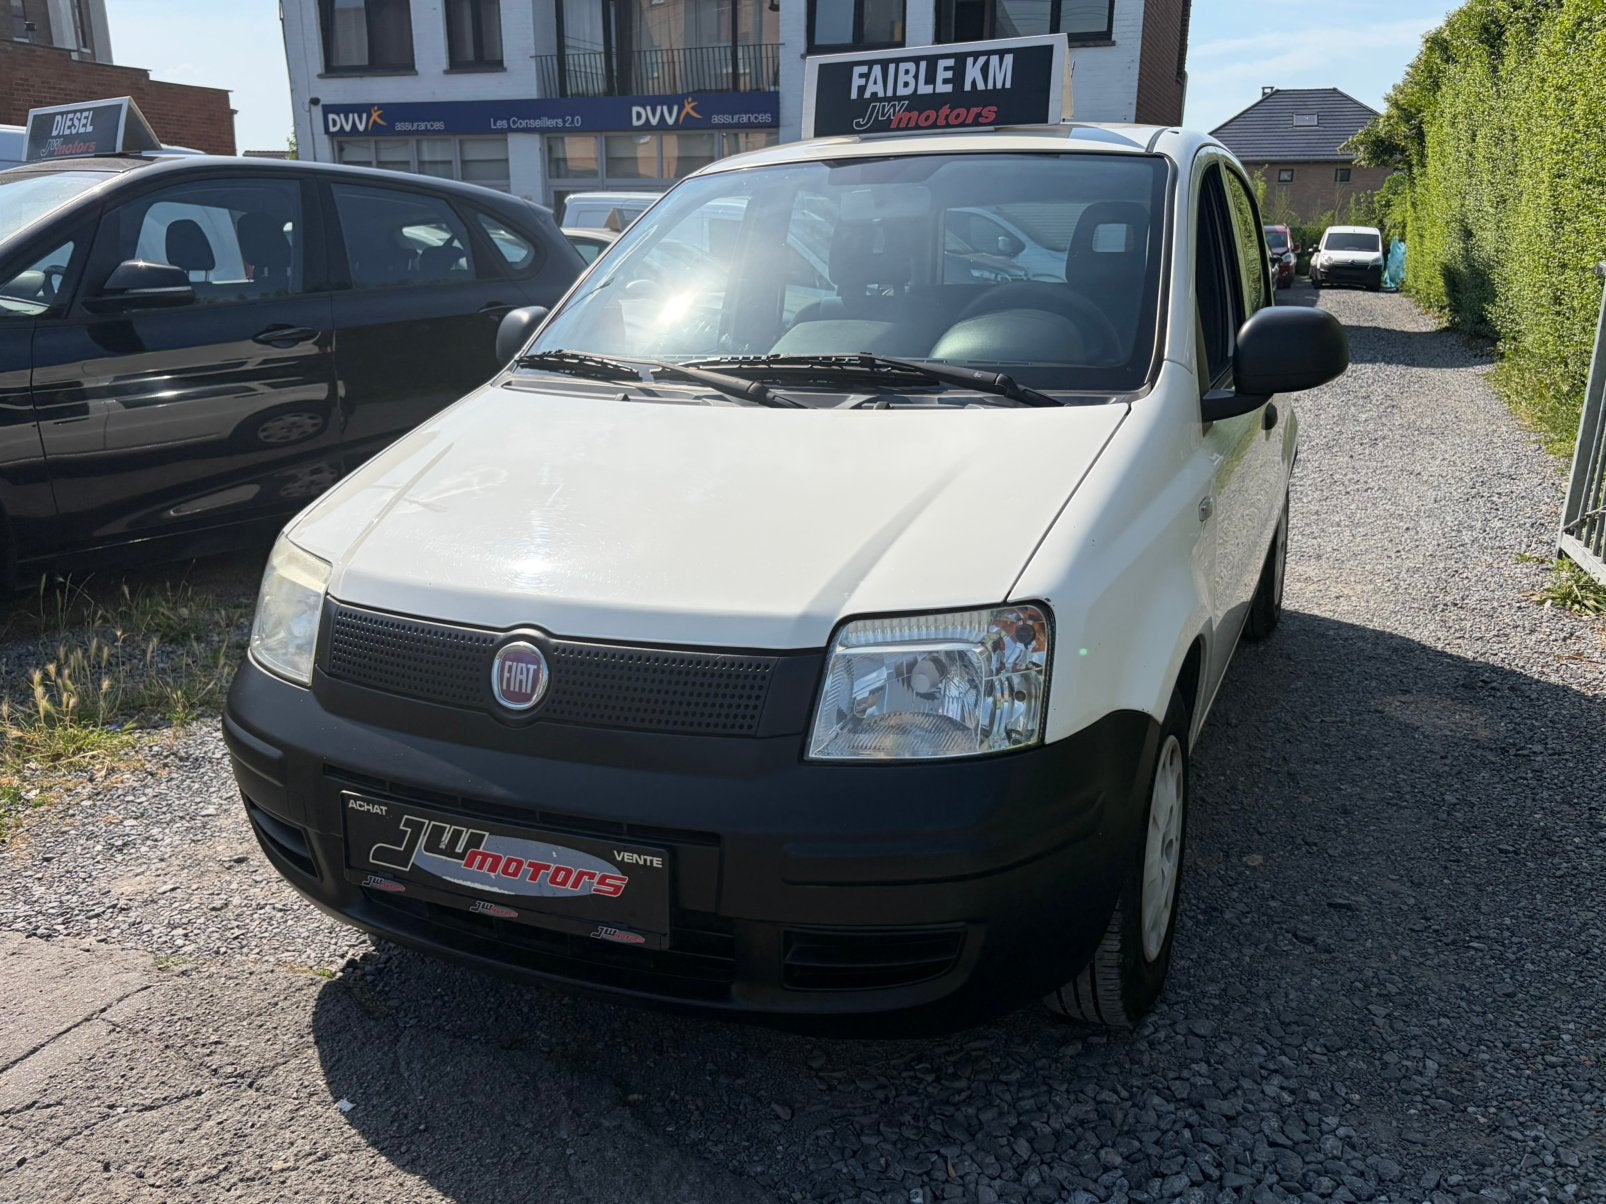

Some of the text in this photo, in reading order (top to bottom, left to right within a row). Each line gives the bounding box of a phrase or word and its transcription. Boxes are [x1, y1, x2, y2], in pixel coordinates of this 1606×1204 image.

[850, 53, 1014, 100] FAIBLE KM
[51, 111, 94, 136] DIESEL
[328, 113, 445, 132] DVV assurances
[490, 115, 582, 129] Les Conseillers 2.0
[631, 105, 772, 126] DVV assurances
[852, 100, 998, 130] JW motors
[54, 141, 96, 155] motors
[502, 661, 538, 694] FIAT
[347, 799, 388, 816] ACHAT
[369, 814, 490, 872] JW
[613, 850, 663, 868] VENTE
